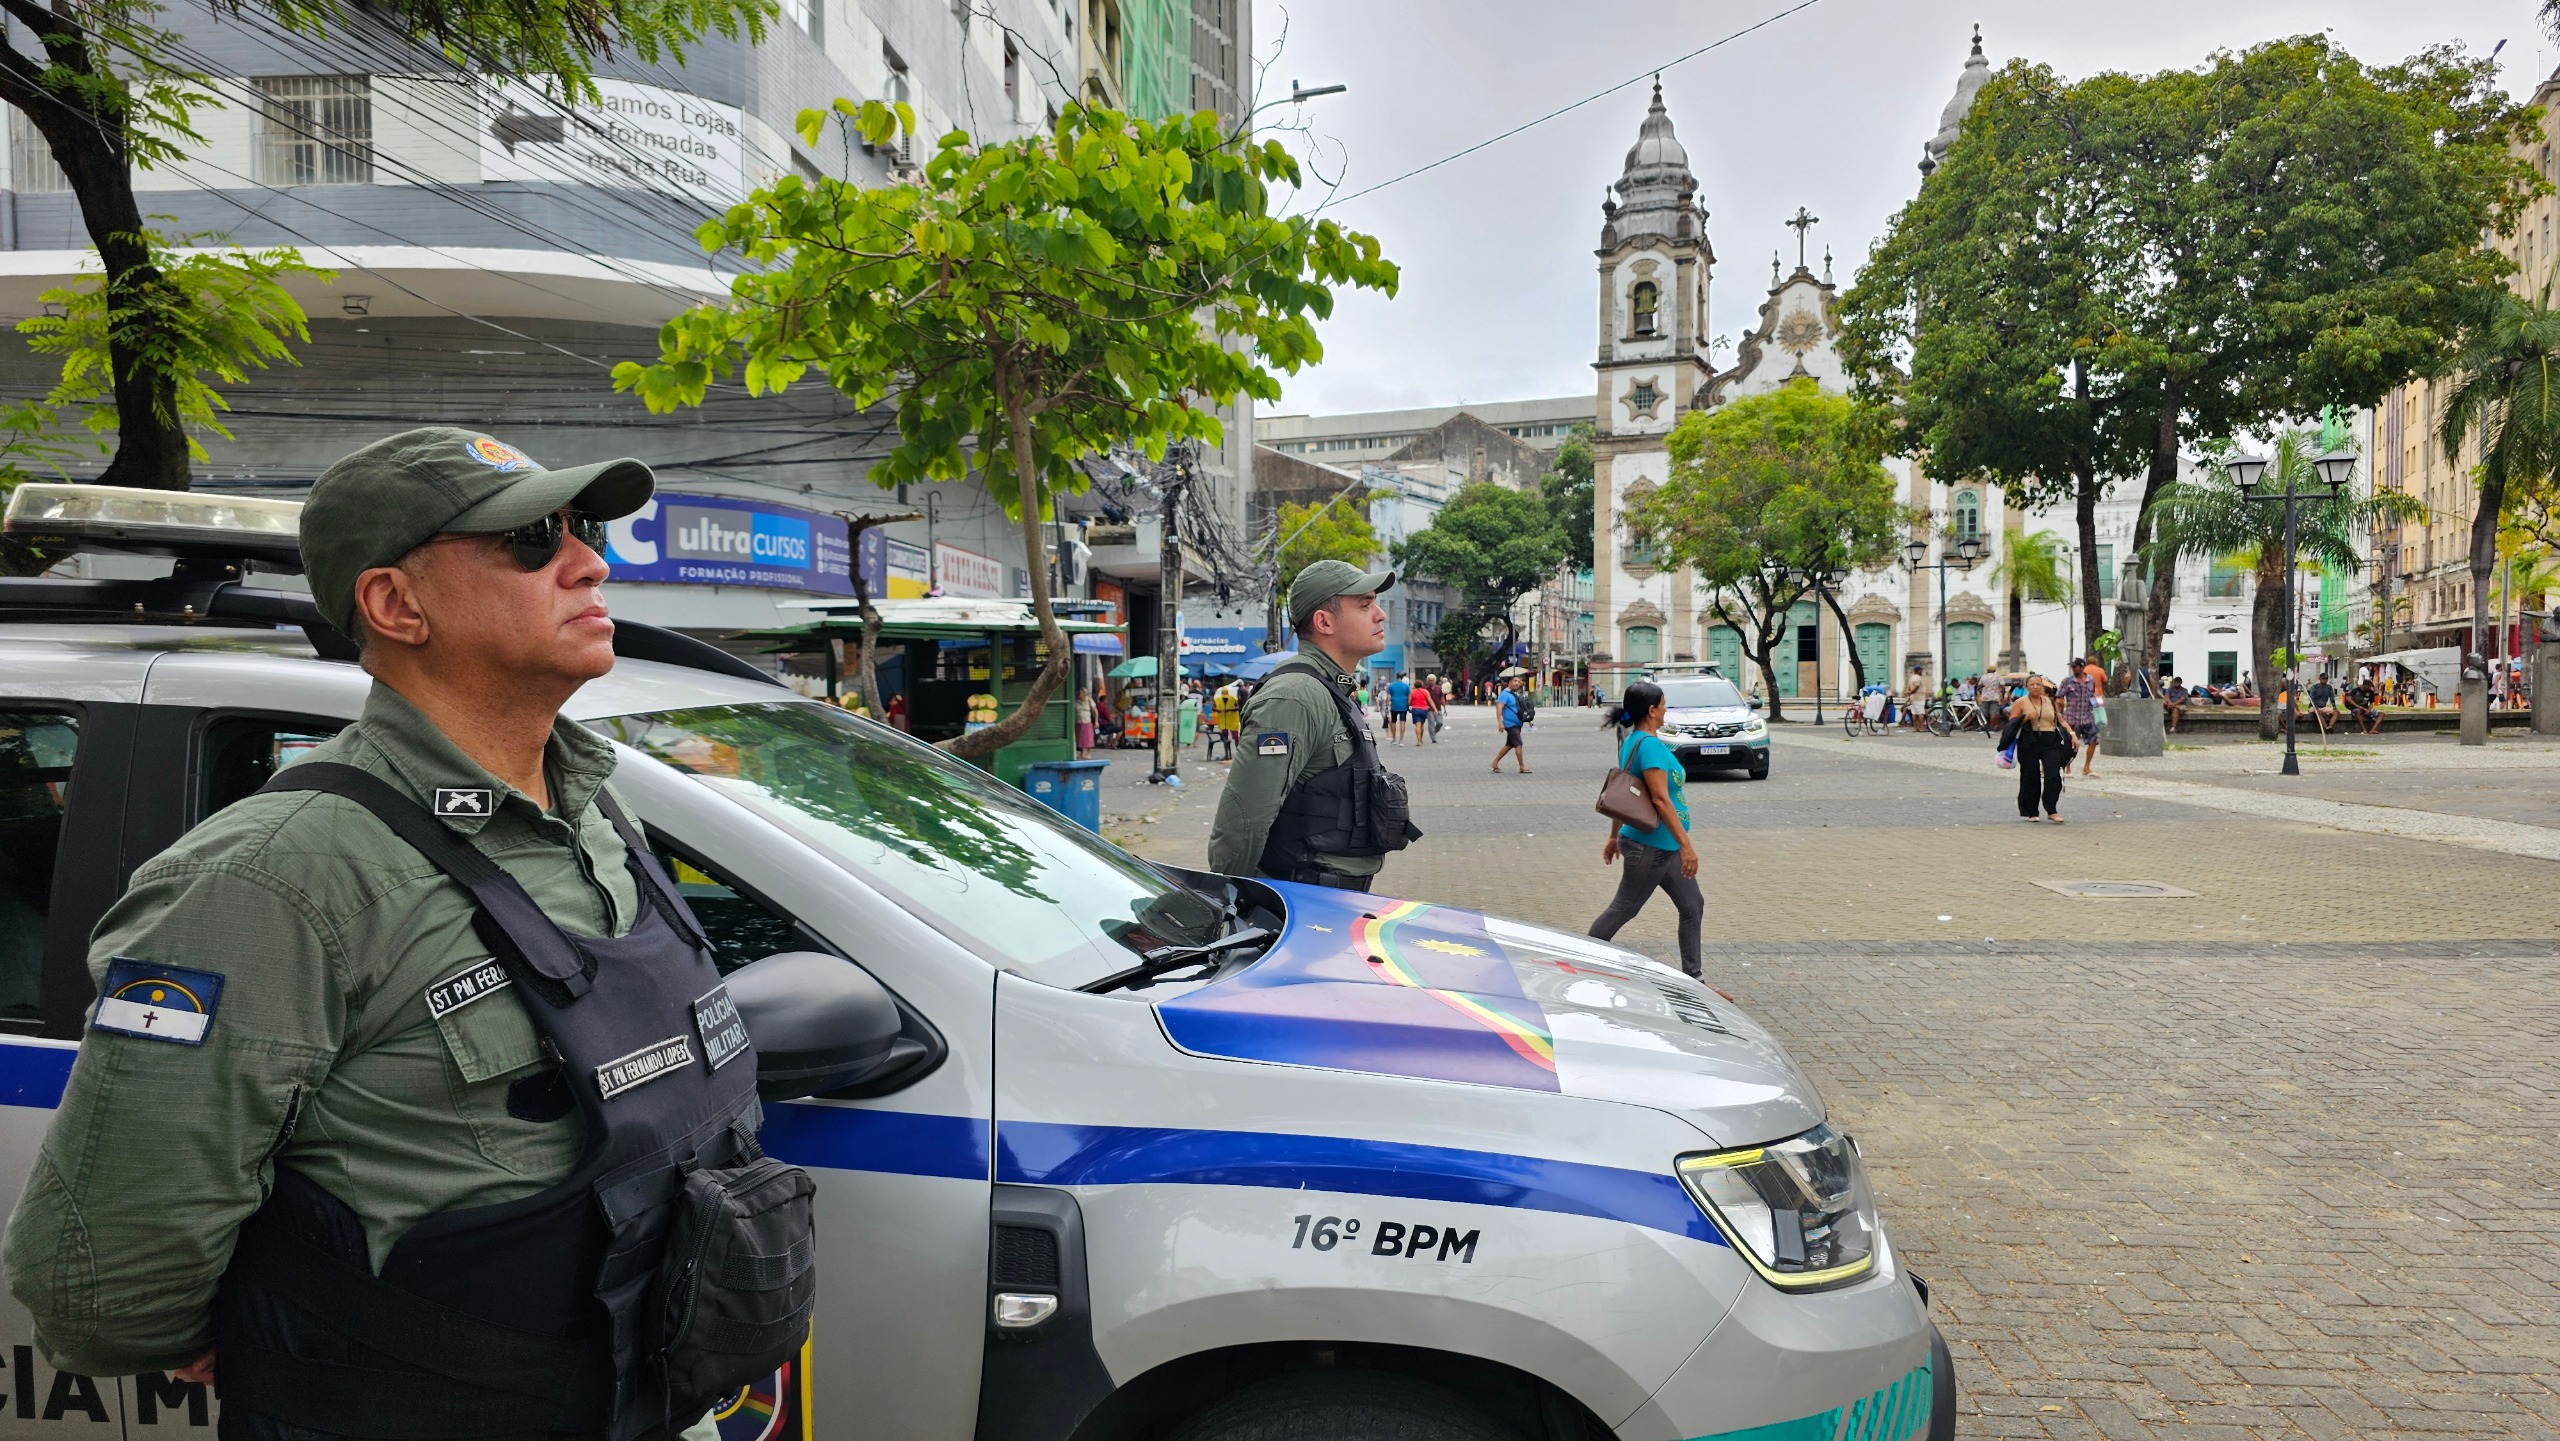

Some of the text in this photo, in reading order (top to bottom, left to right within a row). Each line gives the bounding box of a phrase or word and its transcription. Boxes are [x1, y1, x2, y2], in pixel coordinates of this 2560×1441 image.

[546, 85, 735, 135] Aamos Lojas
[665, 160, 706, 185] Rua
[678, 566, 805, 586] FORMAÇÃO PROFISSIONAL
[433, 987, 452, 1010] ST
[453, 977, 476, 1001] PM
[697, 996, 735, 1034] POLÍCIA
[705, 1023, 745, 1063] MILITAR
[600, 1044, 687, 1092] ST PM FERNANDO LOPES
[1371, 1221, 1481, 1264] BPM
[0, 1344, 111, 1422] IA
